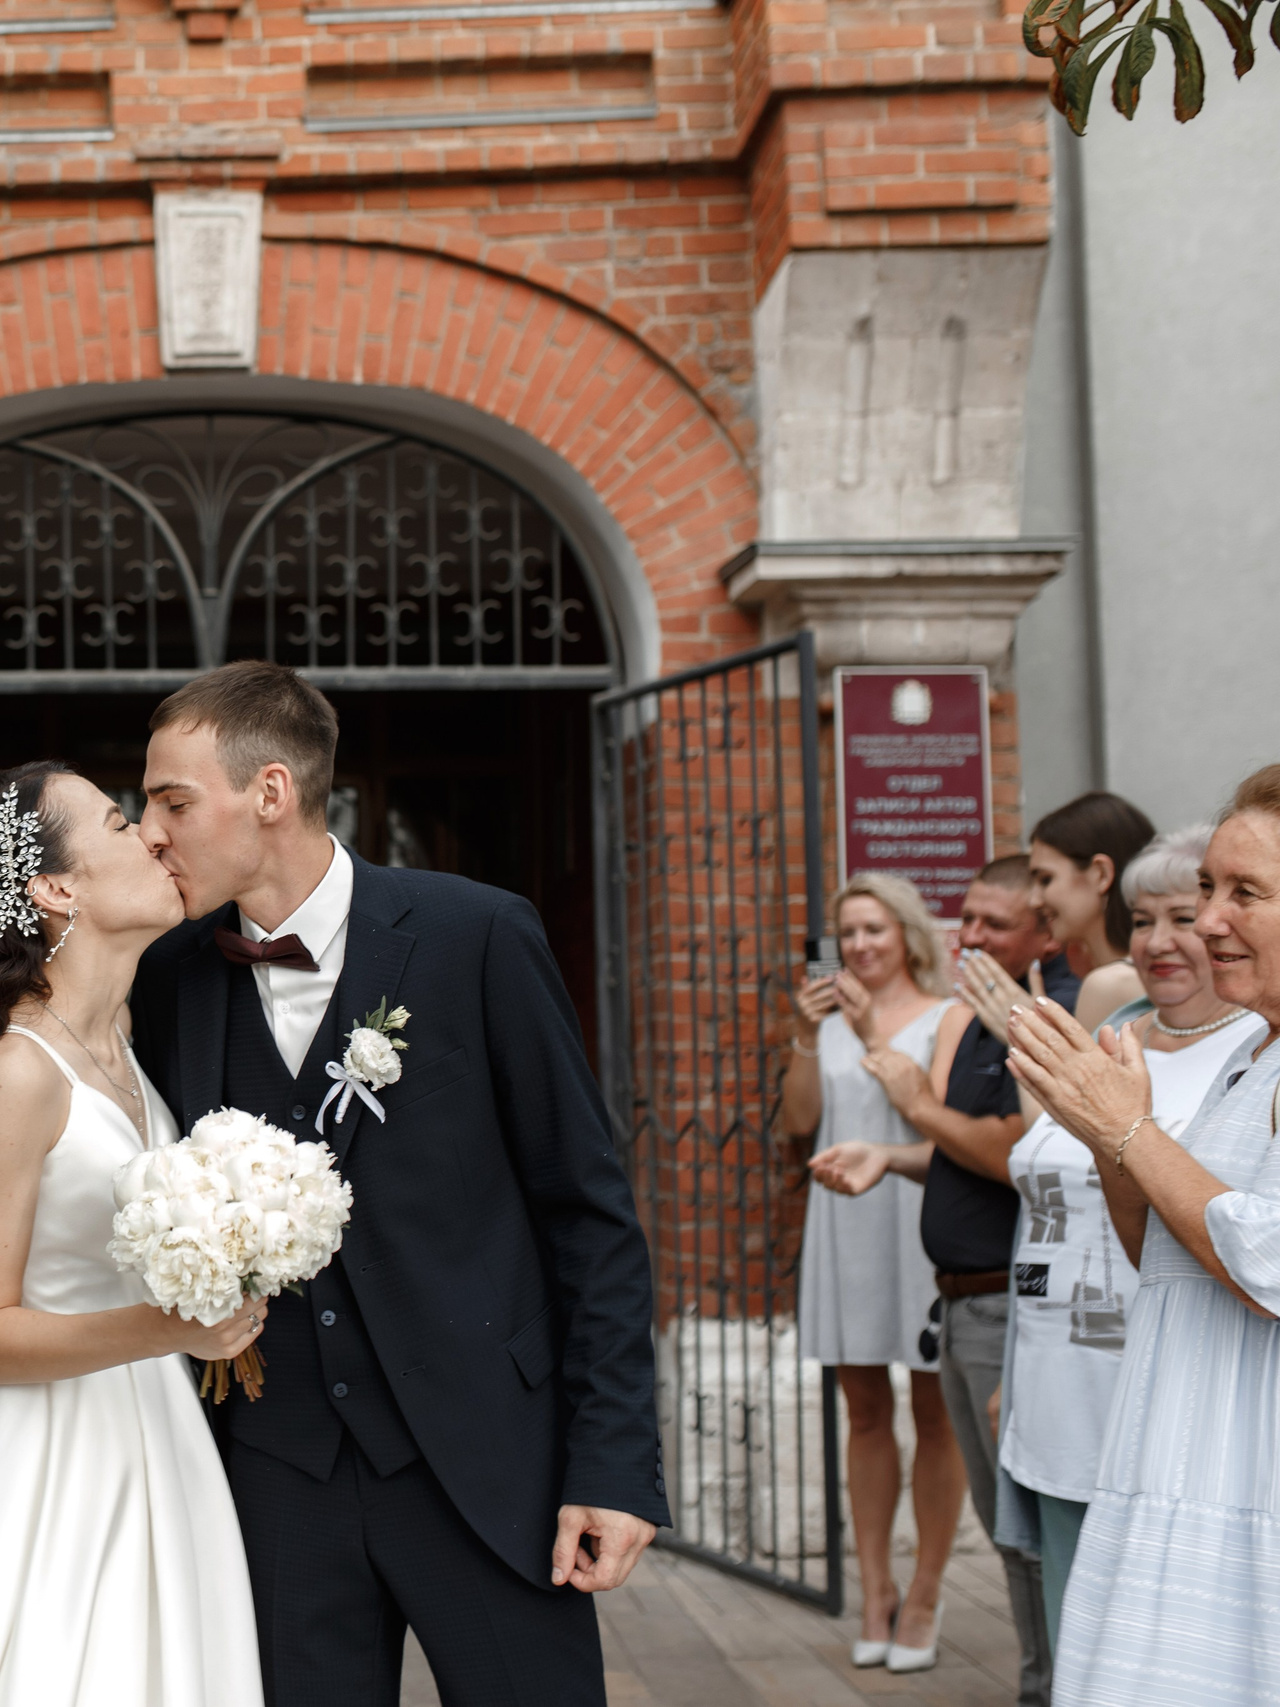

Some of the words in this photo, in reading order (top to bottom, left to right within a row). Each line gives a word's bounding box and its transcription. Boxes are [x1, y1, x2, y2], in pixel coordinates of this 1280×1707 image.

[886, 775, 942, 792] ОТДЕЛ
[854, 797, 921, 814] ЗАПИСИ
[923, 797, 977, 814] АКТОВ
[852, 819, 981, 836] ГРАЖДАНСКОГО
[866, 841, 967, 858] СОСТОЯНИЯ
